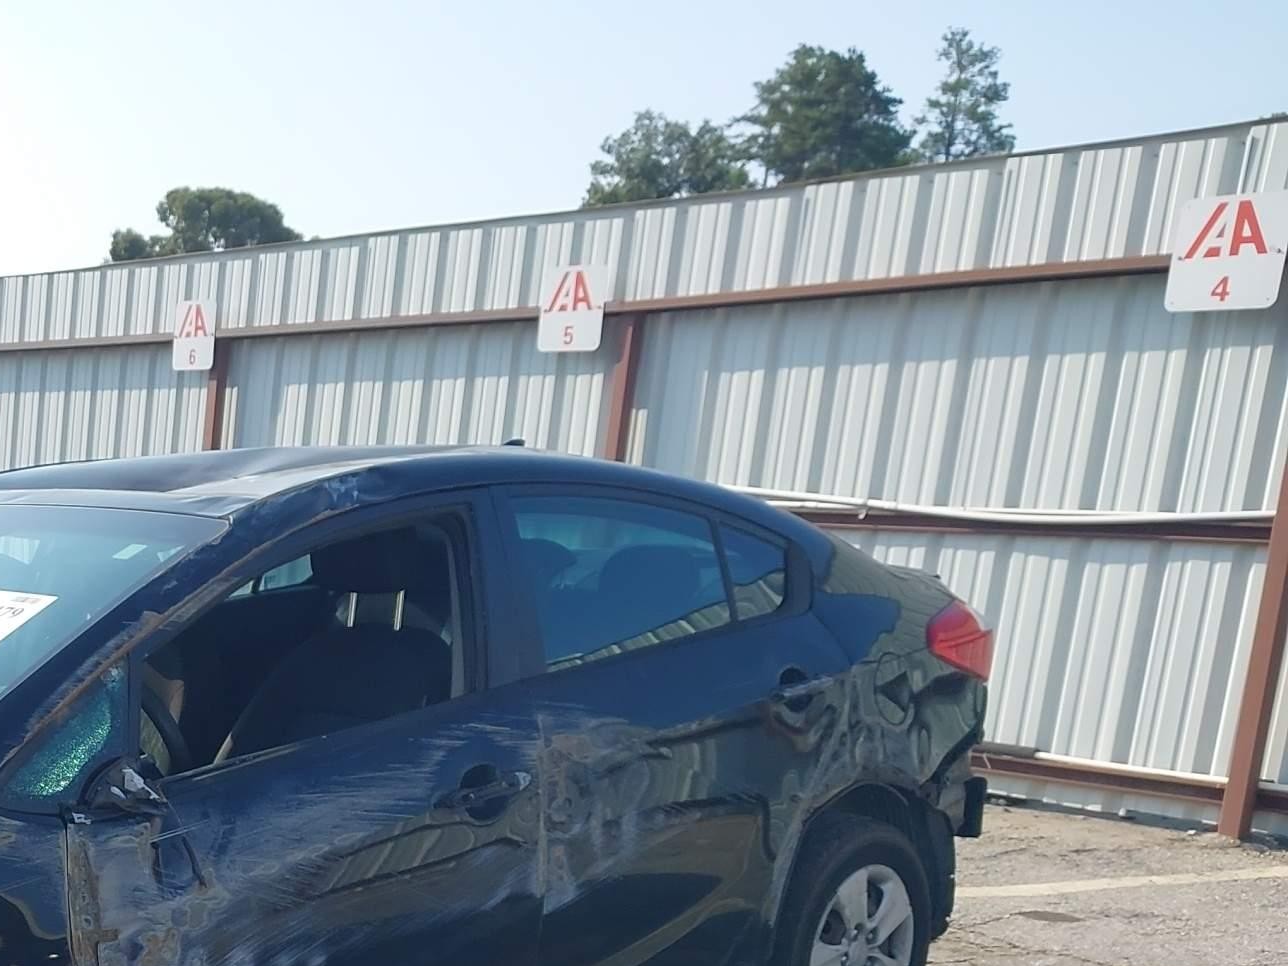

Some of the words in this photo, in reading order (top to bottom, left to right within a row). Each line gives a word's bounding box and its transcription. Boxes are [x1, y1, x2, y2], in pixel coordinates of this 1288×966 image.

[1210, 275, 1230, 302] 4
[563, 325, 574, 345] 5
[189, 348, 196, 365] 6
